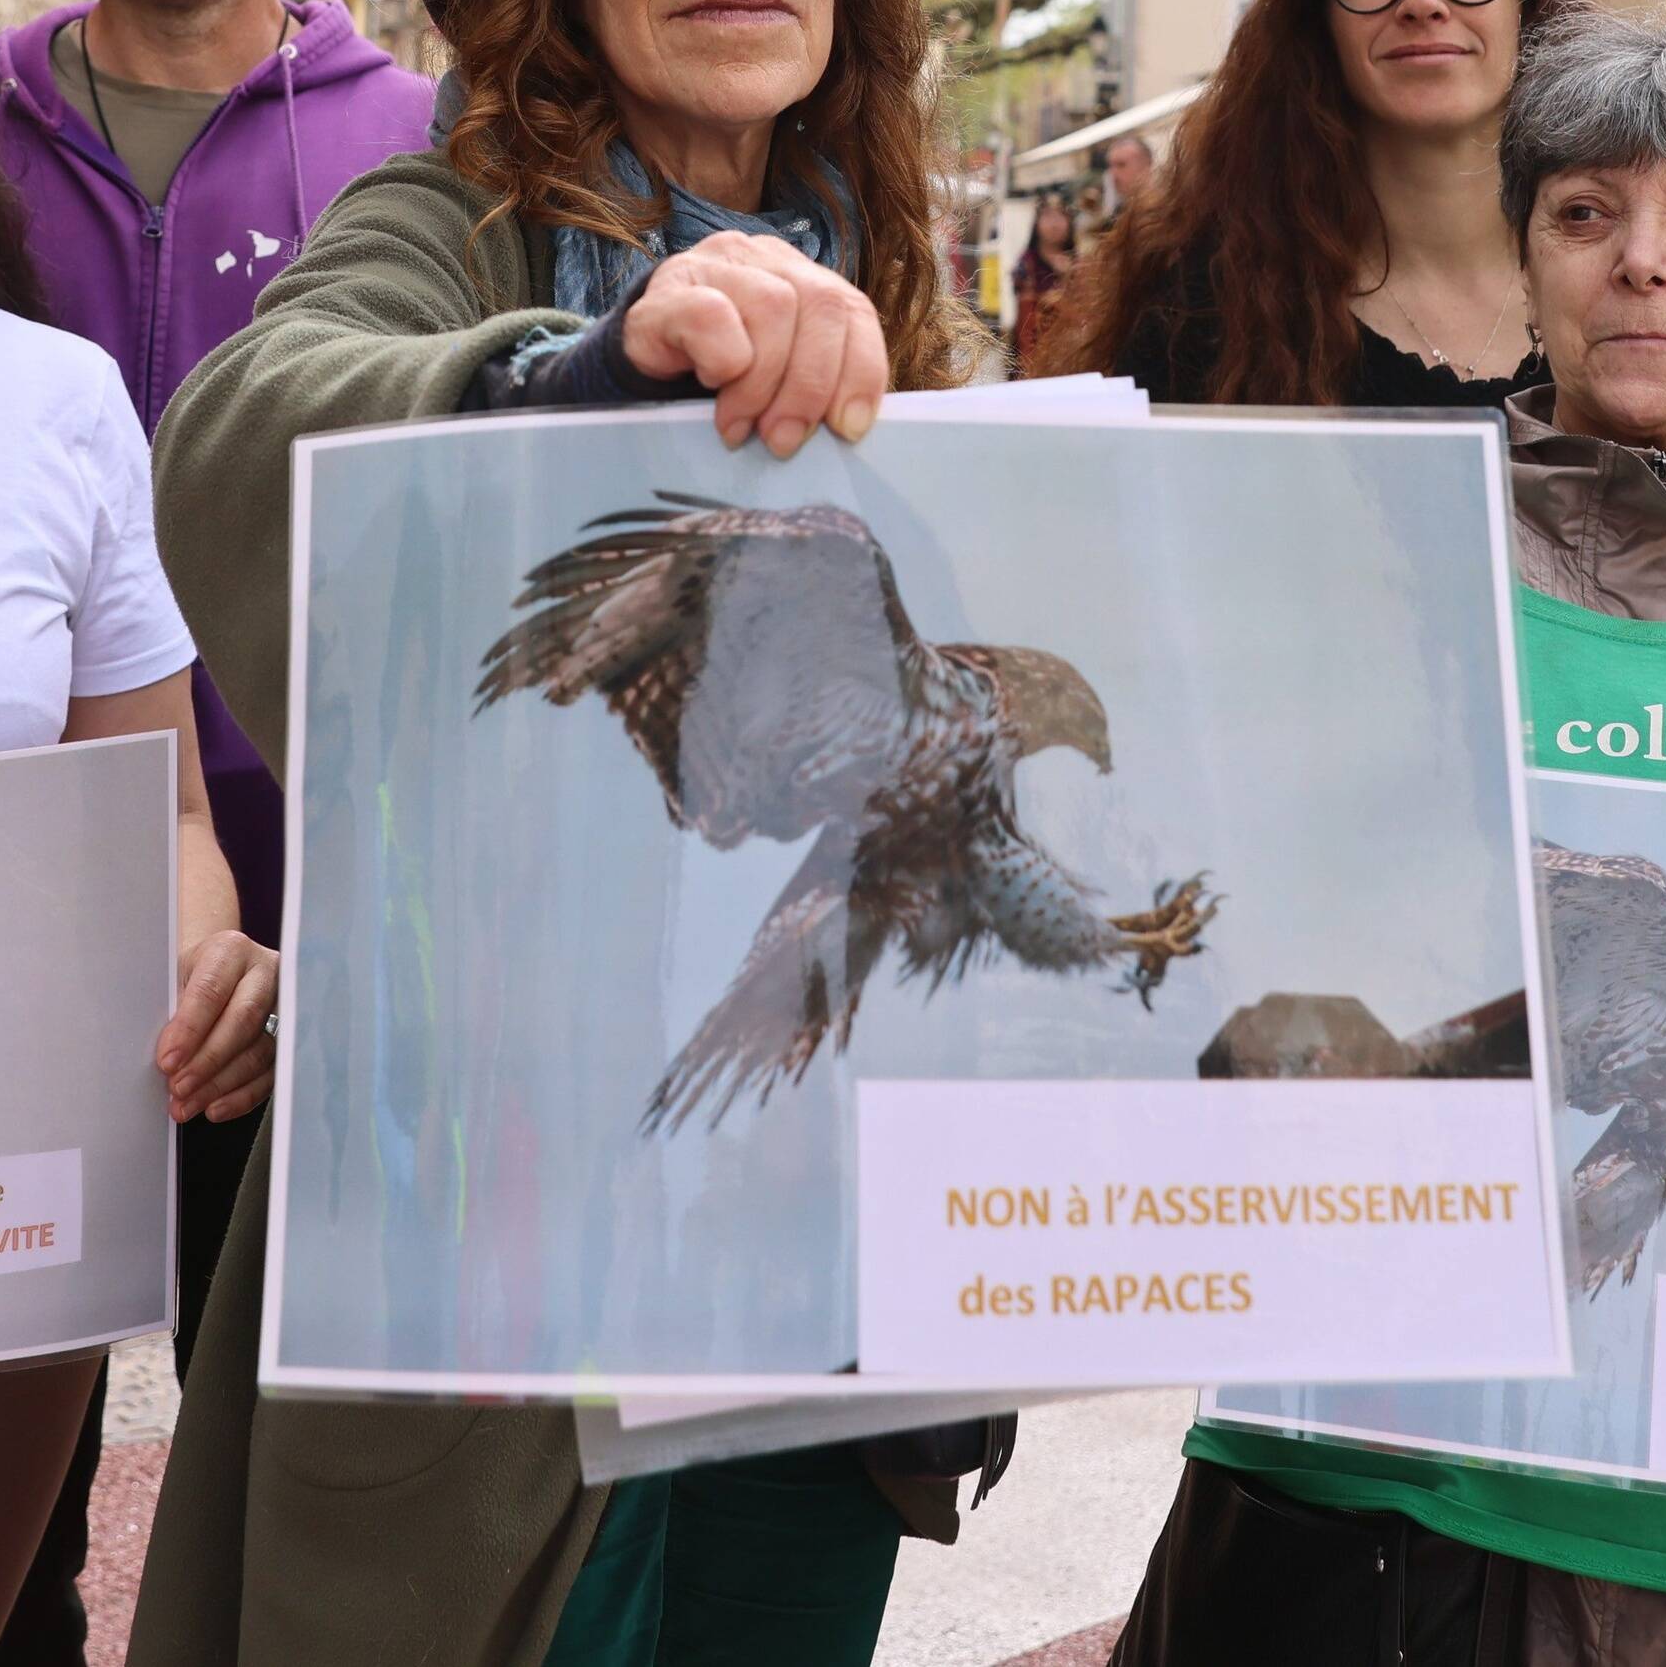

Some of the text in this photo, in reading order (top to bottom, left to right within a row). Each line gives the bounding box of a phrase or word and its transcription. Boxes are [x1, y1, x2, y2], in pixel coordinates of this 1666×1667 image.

[947, 1188, 1050, 1227] NON
[1066, 1185, 1089, 1227] à
[959, 1273, 1252, 1316] des RAPACES
